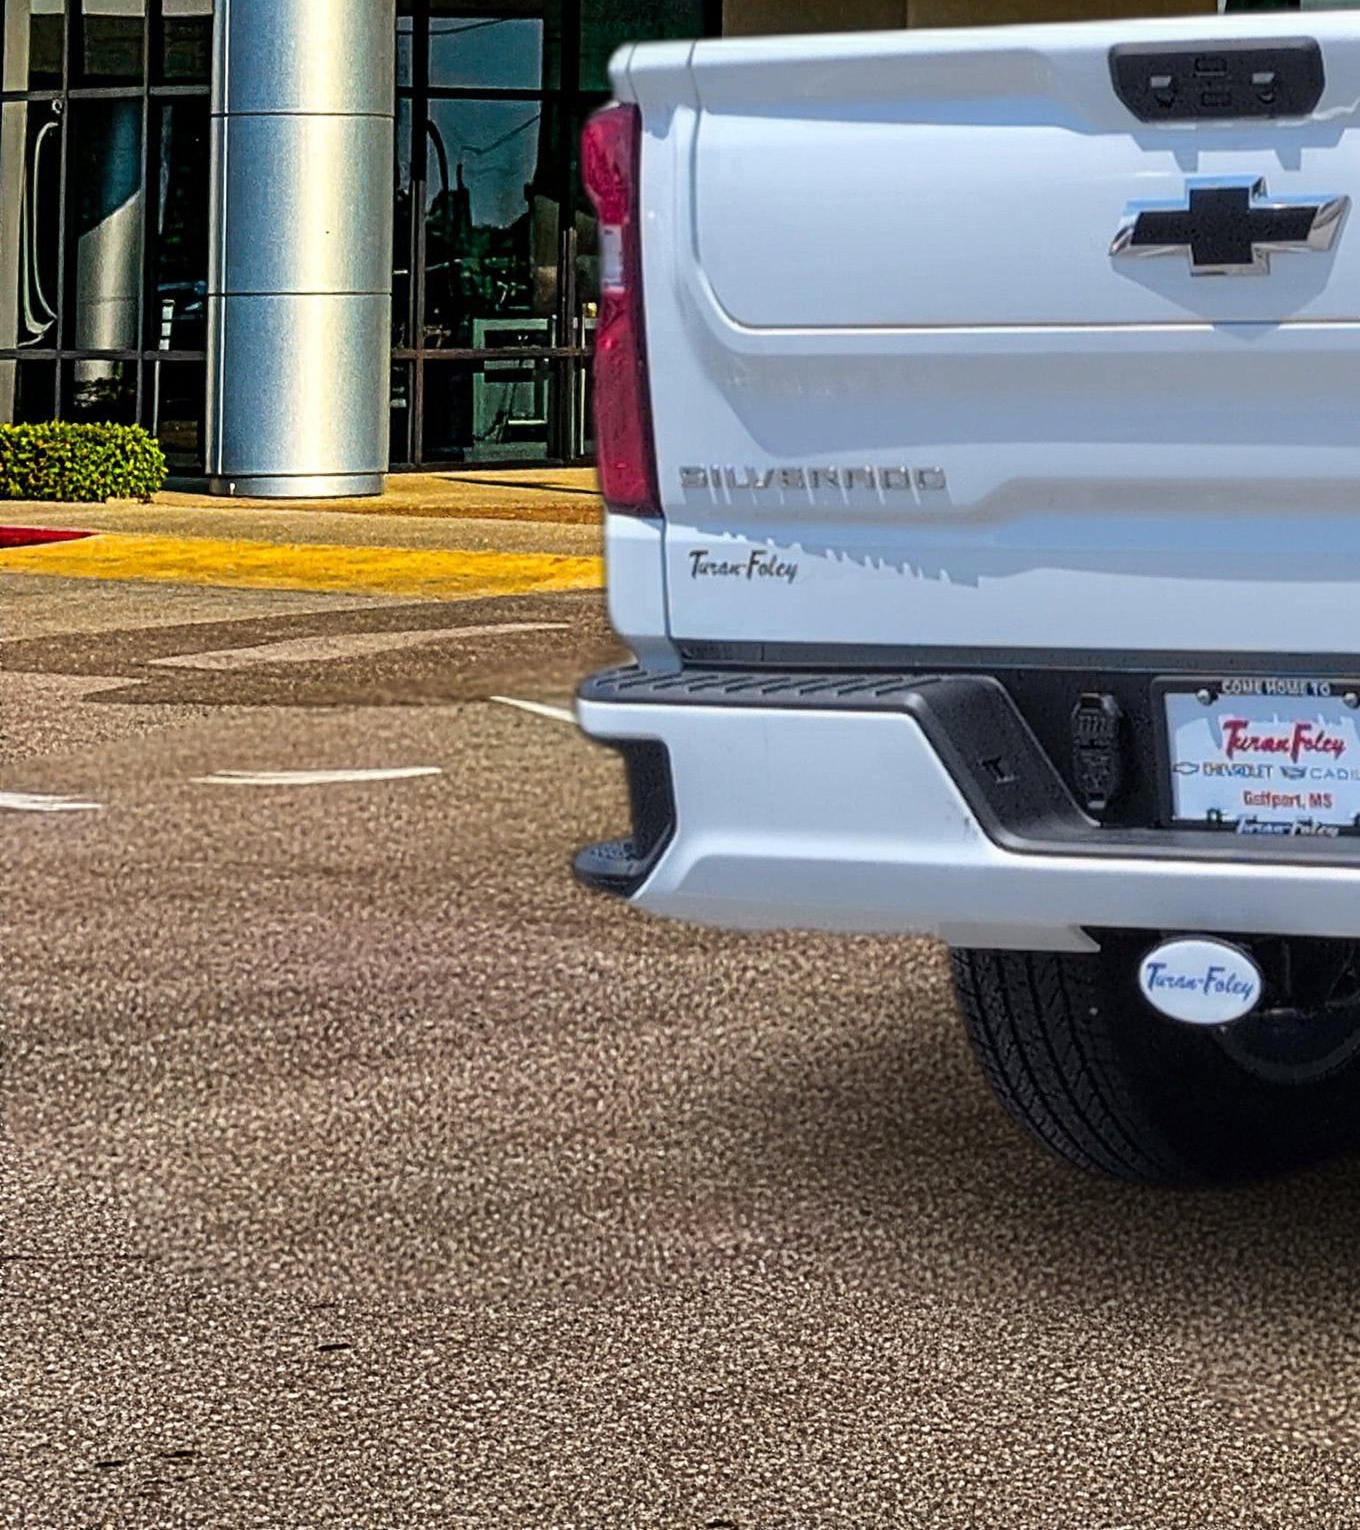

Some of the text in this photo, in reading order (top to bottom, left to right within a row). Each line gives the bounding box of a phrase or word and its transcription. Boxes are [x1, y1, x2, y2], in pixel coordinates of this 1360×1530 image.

[679, 465, 947, 490] SILVERADO
[1203, 763, 1273, 778] CHEVROLET
[1309, 793, 1333, 809] MS
